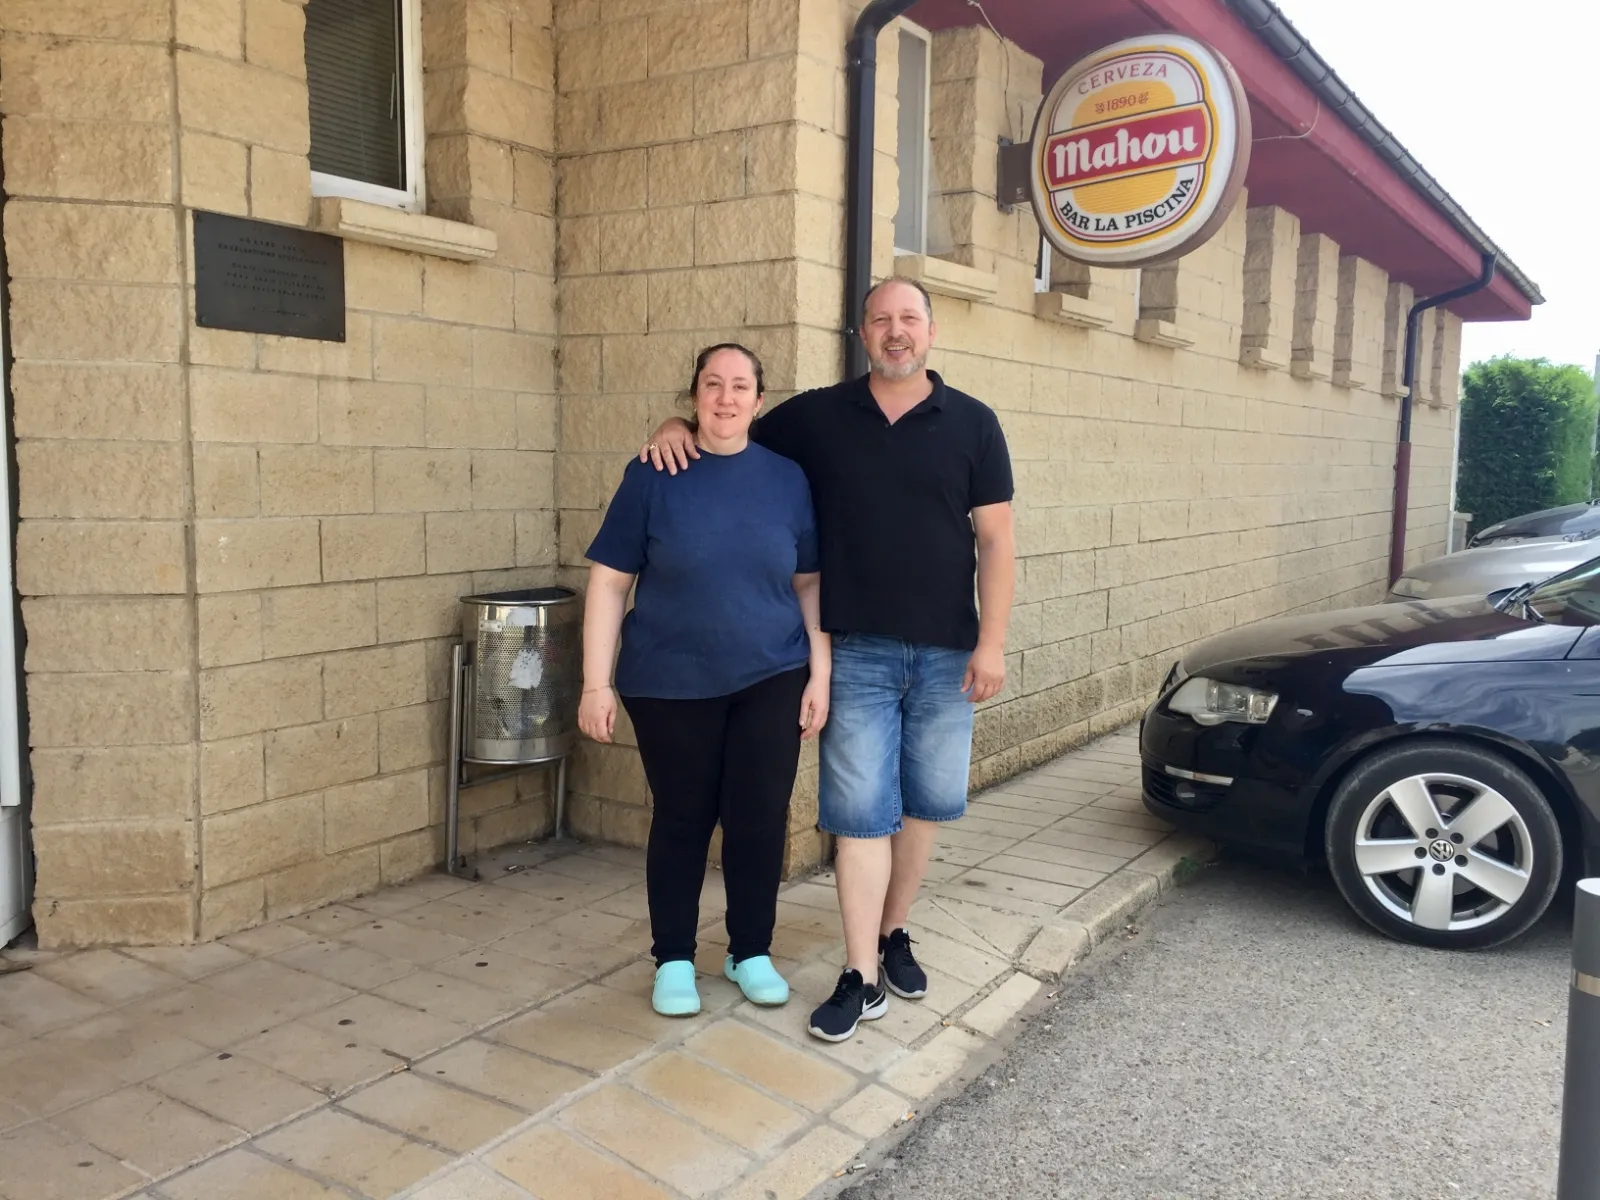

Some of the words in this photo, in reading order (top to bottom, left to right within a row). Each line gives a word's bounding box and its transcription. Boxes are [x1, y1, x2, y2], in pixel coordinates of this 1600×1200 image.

[1078, 62, 1167, 95] CERVEZA
[1106, 95, 1137, 112] 1890
[1053, 126, 1198, 178] Mahou
[1059, 200, 1090, 230] BAR
[1095, 217, 1119, 231] LA
[1124, 177, 1194, 228] PISCINA
